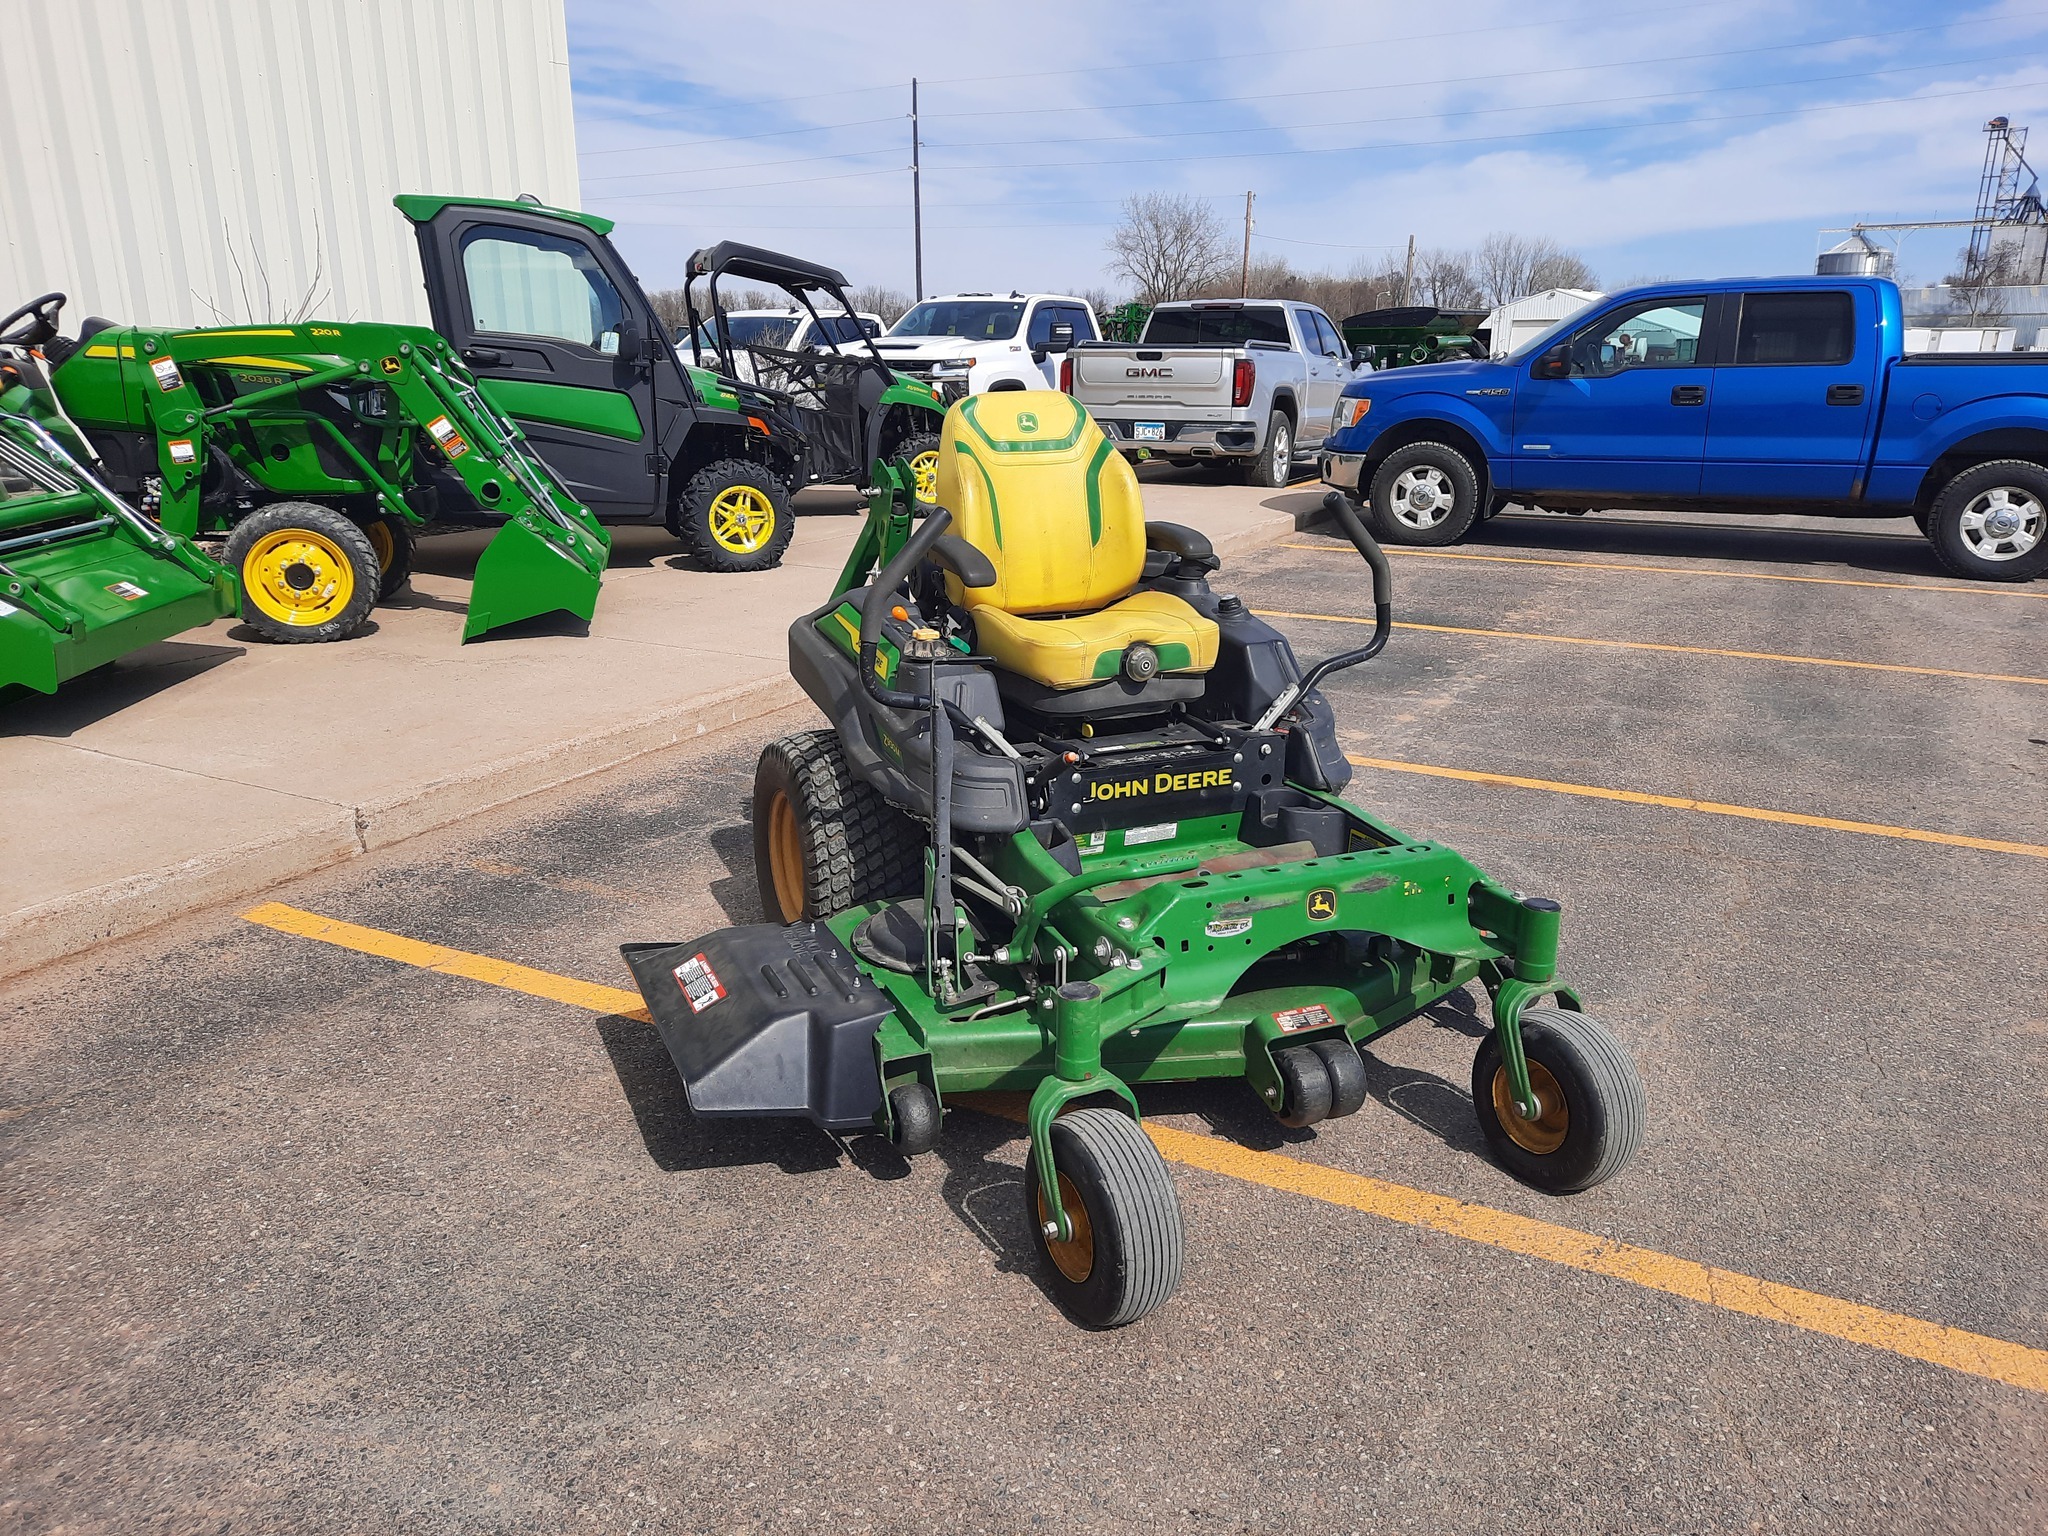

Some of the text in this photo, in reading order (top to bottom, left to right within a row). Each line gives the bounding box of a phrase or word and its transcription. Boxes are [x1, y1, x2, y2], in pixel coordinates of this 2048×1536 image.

[1126, 367, 1174, 378] GMC
[1083, 768, 1233, 802] JOHN DEERE
